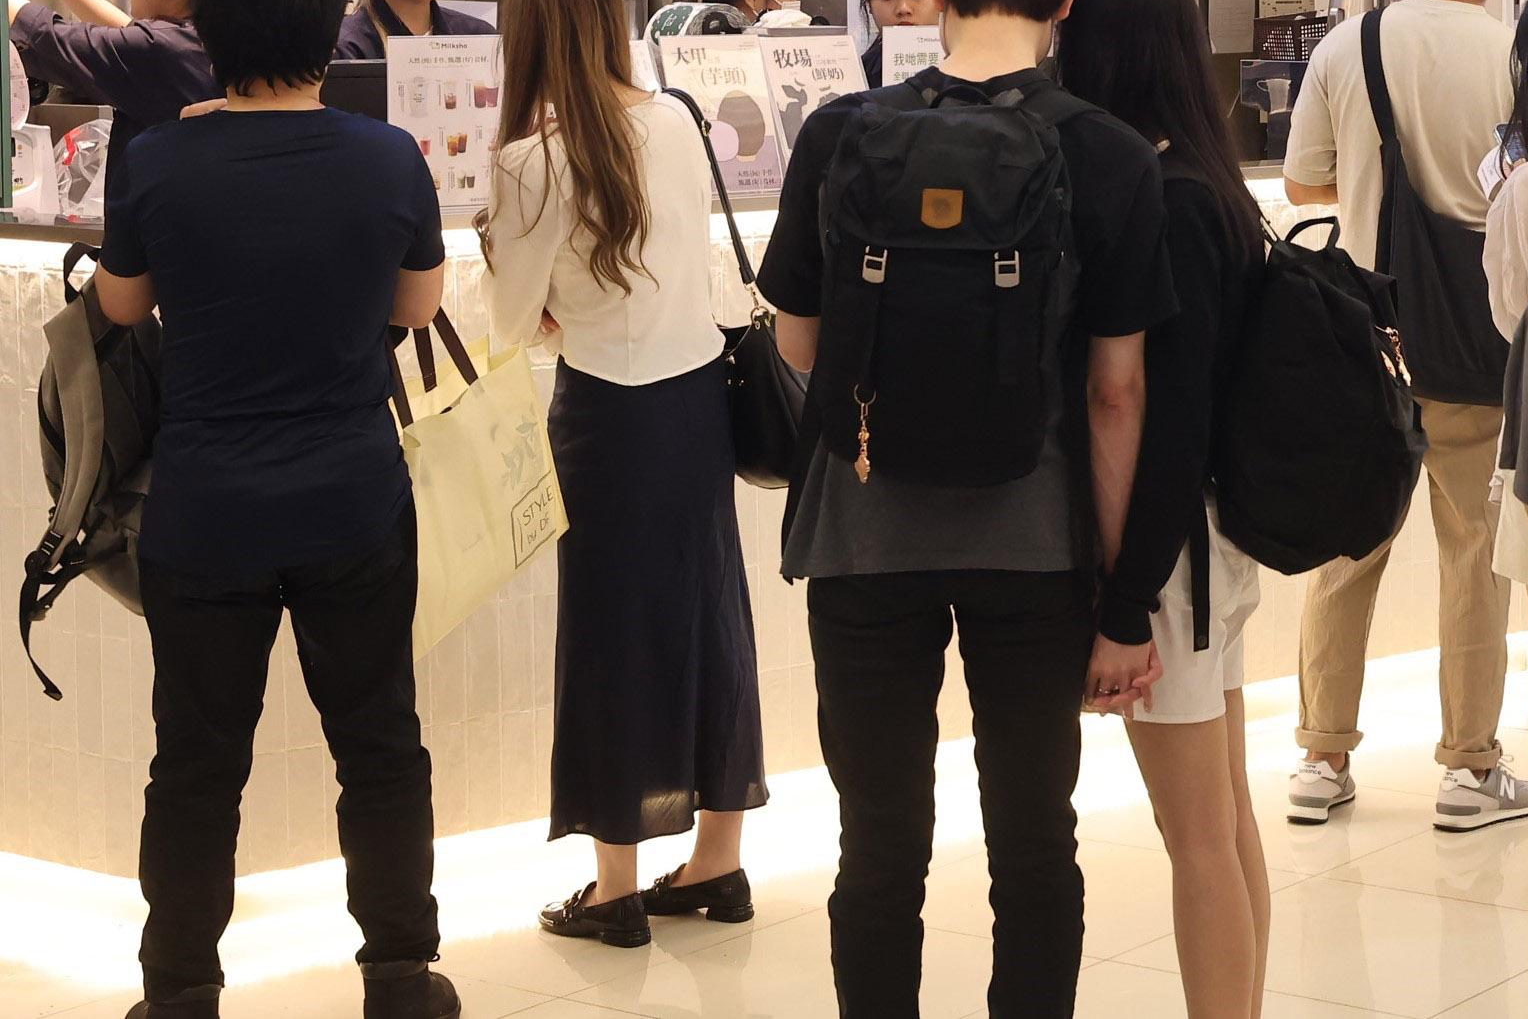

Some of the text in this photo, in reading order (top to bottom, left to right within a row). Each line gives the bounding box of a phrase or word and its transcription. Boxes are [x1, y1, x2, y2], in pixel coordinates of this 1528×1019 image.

[671, 47, 707, 65] 大甲
[773, 48, 812, 69] 牧場
[700, 67, 747, 86] (芋頭)
[811, 68, 844, 82] (鮮奶)
[522, 485, 554, 526] STYLE
[1499, 774, 1516, 801] N
